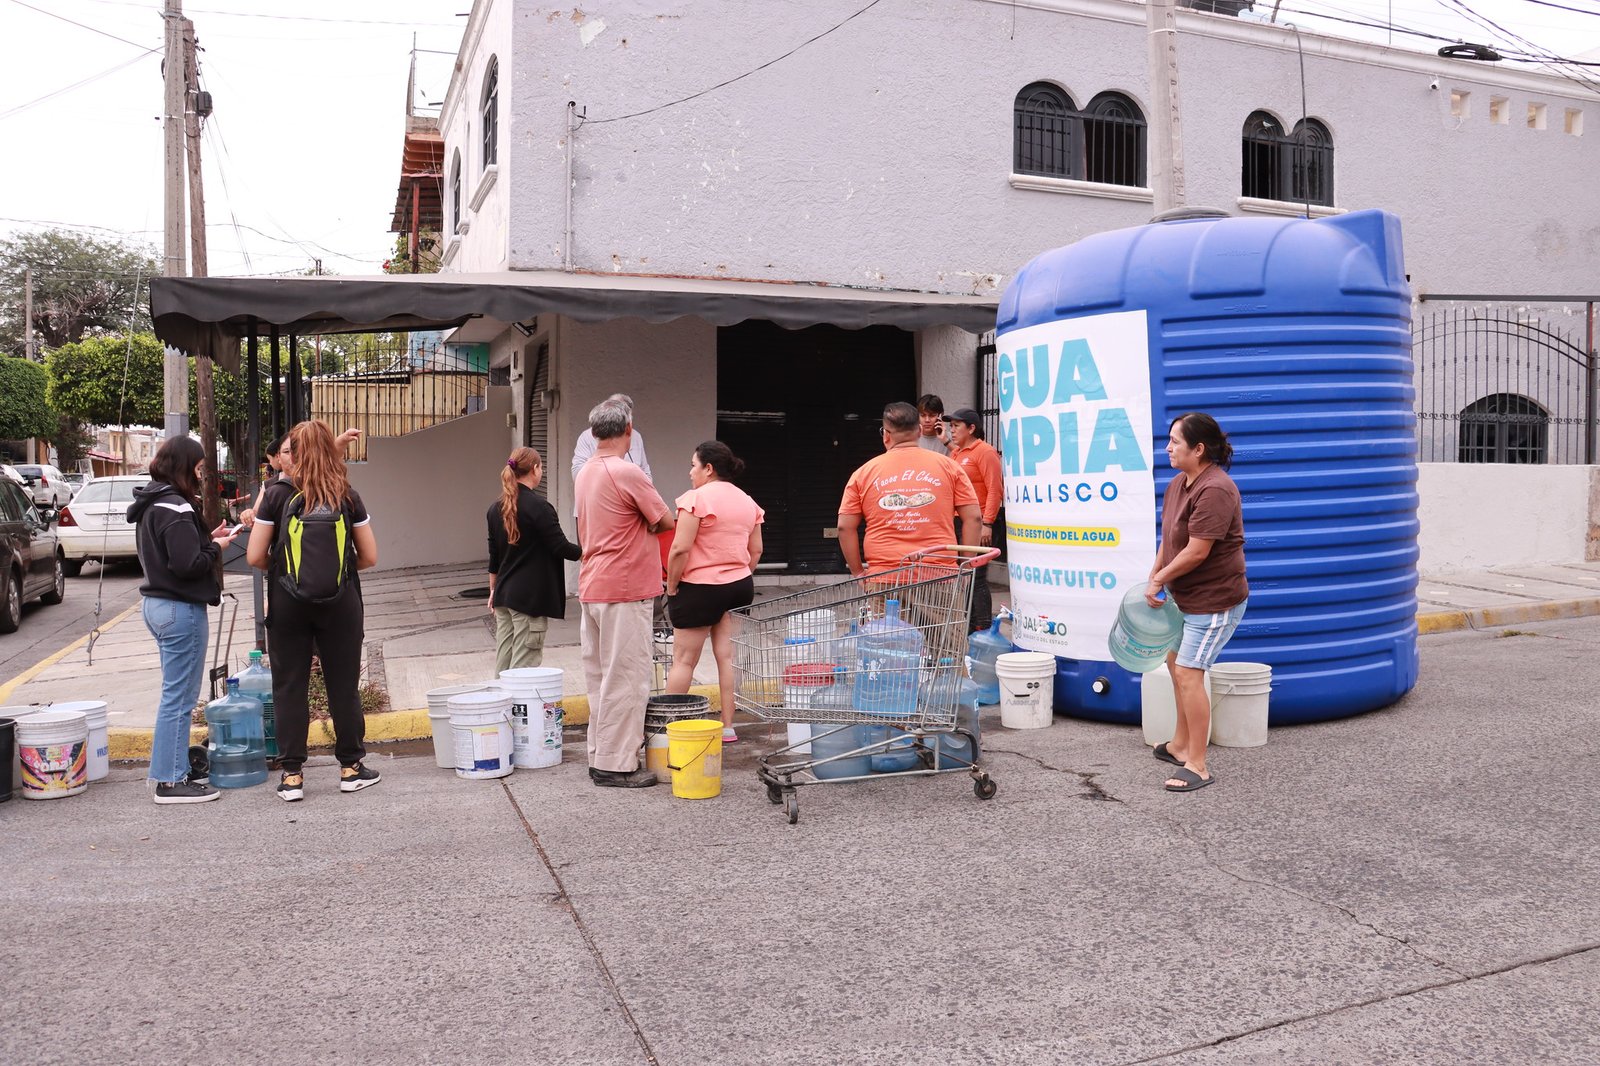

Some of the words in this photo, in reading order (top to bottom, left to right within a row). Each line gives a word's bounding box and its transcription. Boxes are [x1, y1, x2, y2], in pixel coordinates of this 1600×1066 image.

[998, 338, 1109, 413] GUA
[901, 469, 915, 481] El
[1015, 480, 1119, 503] JALISCO
[1025, 527, 1058, 540] GESTIÓN
[1060, 531, 1079, 541] DEL
[1082, 531, 1116, 542] AGUA
[1024, 565, 1117, 590] GRATUITO
